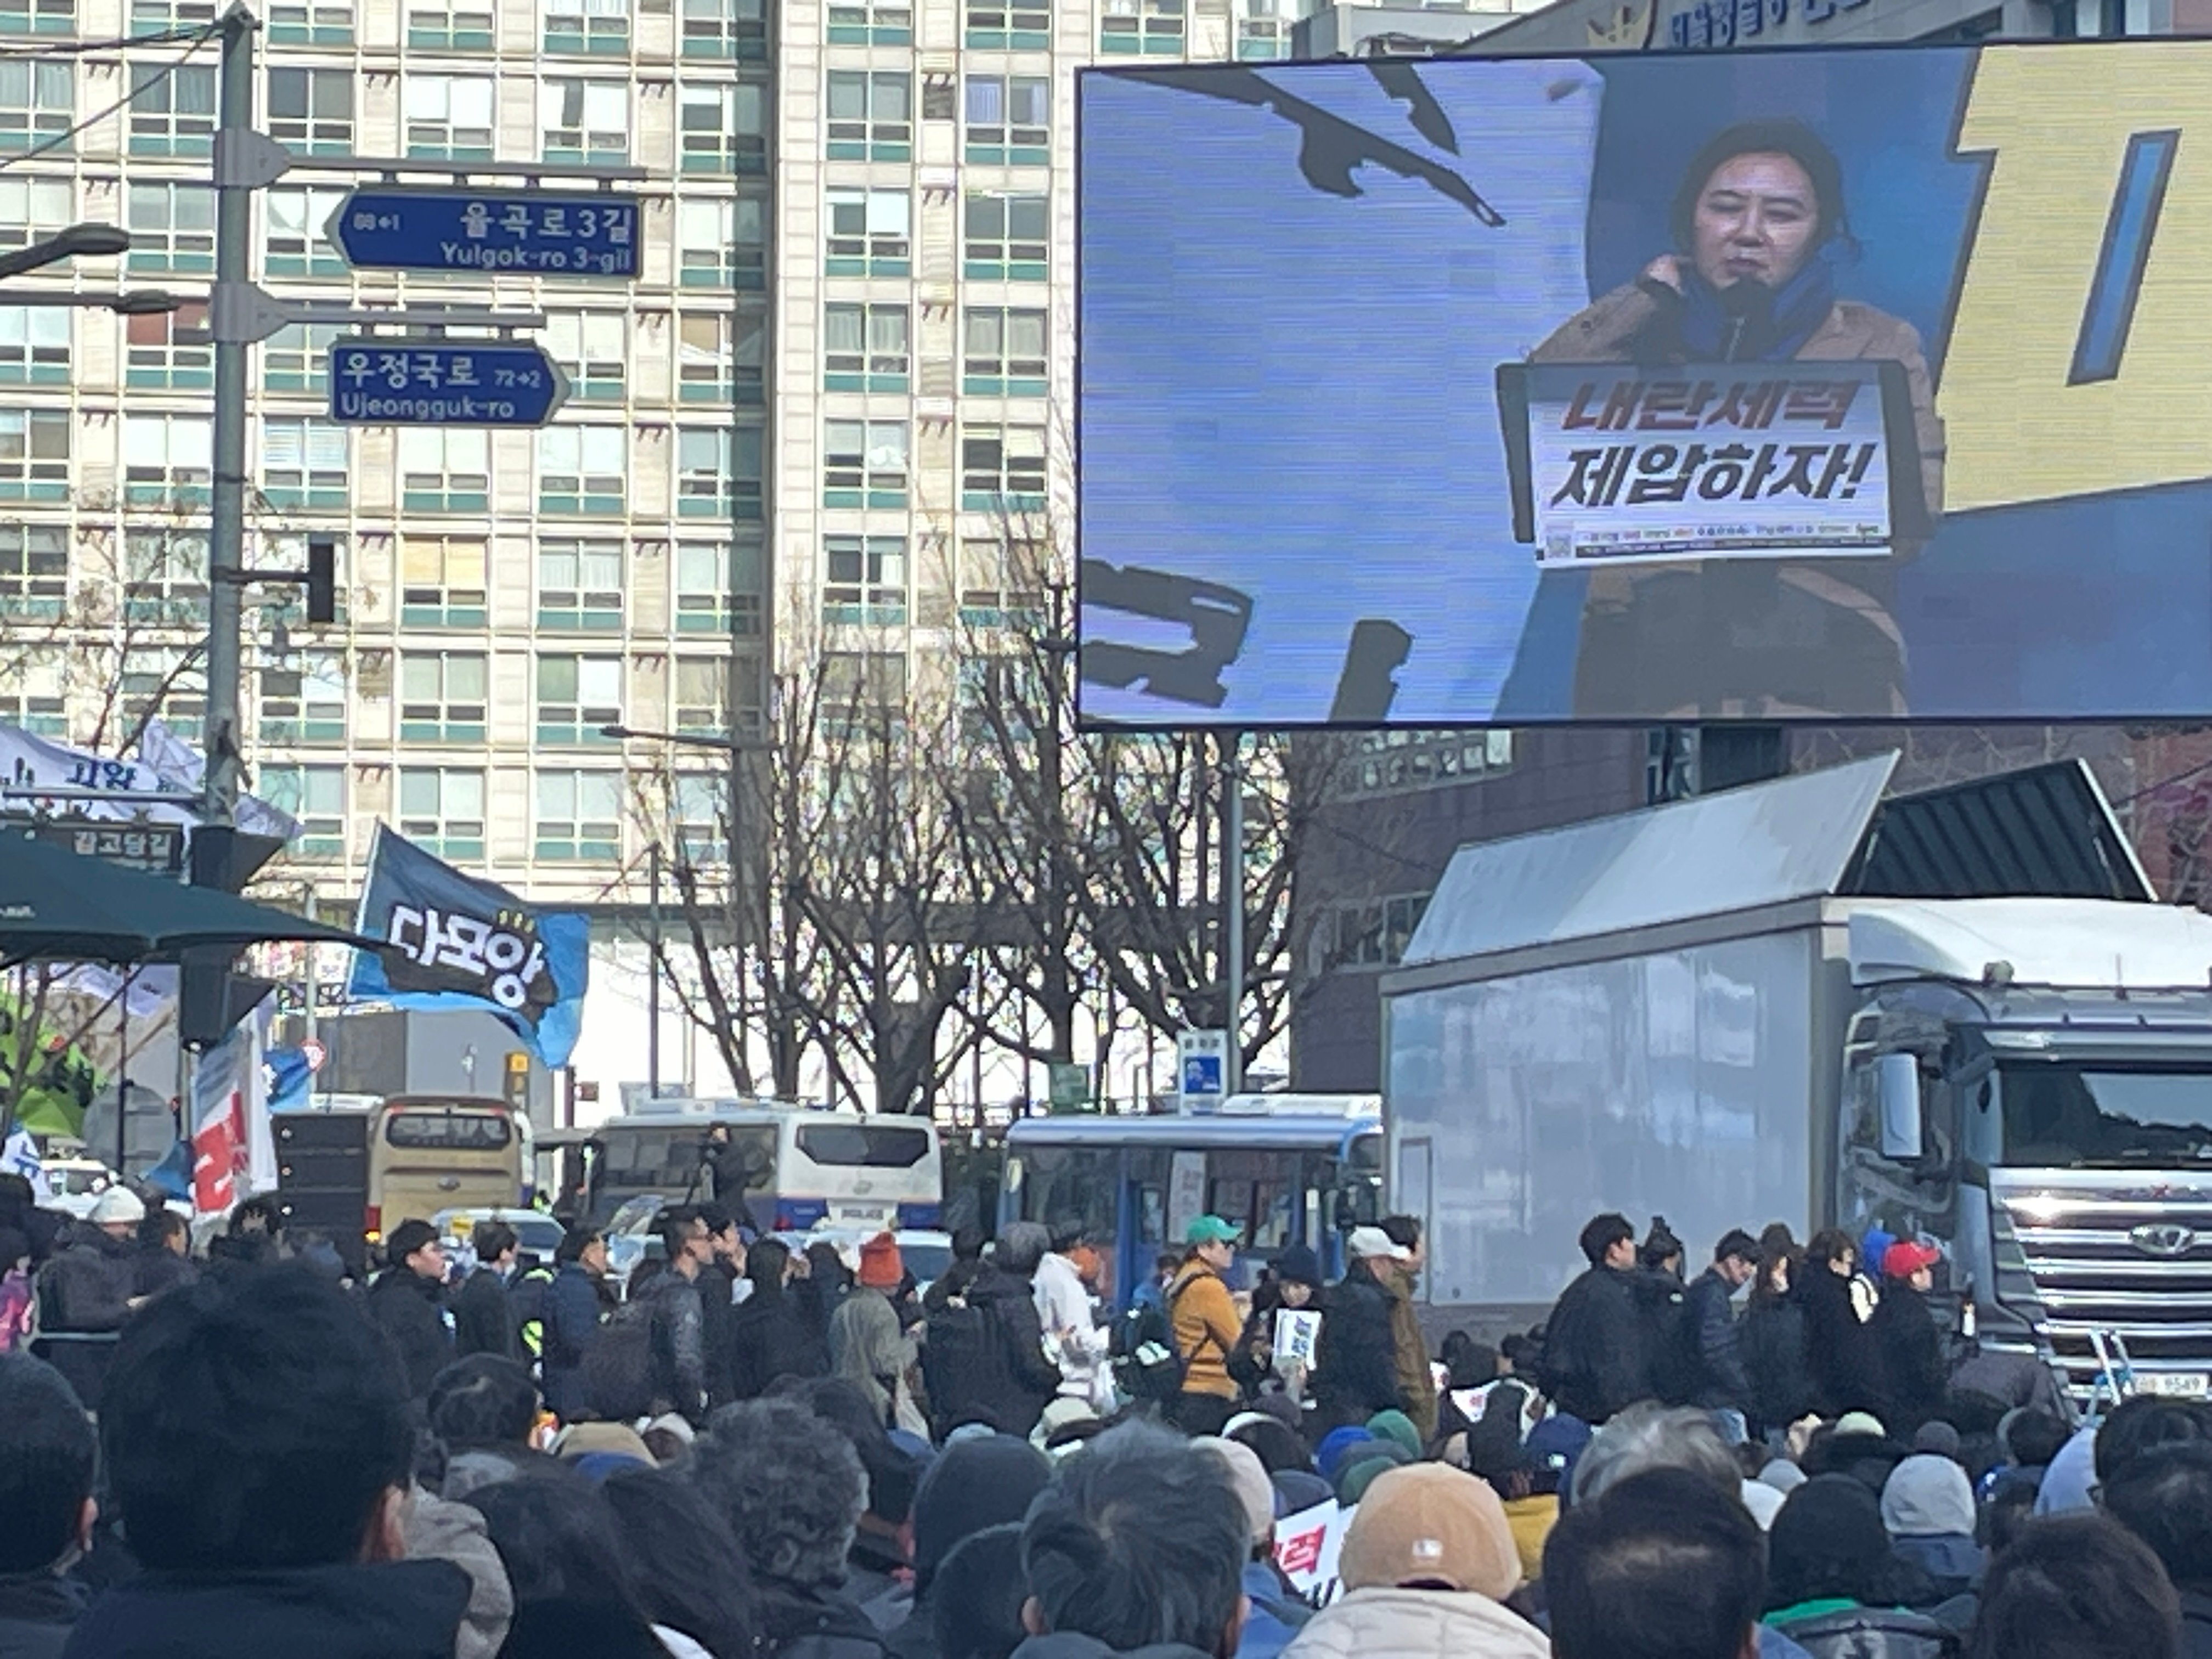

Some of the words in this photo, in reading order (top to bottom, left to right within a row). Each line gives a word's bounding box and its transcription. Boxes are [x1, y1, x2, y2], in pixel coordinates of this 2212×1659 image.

[441, 242, 566, 268] Yulgok-ro
[573, 247, 631, 273] 3-gil
[341, 354, 480, 388] 우정국로
[341, 393, 515, 420] Ujeongguk-ro
[1561, 380, 1861, 430] 내란세력
[1550, 443, 1877, 507] 제압하자!
[389, 904, 545, 1008] 다모앙
